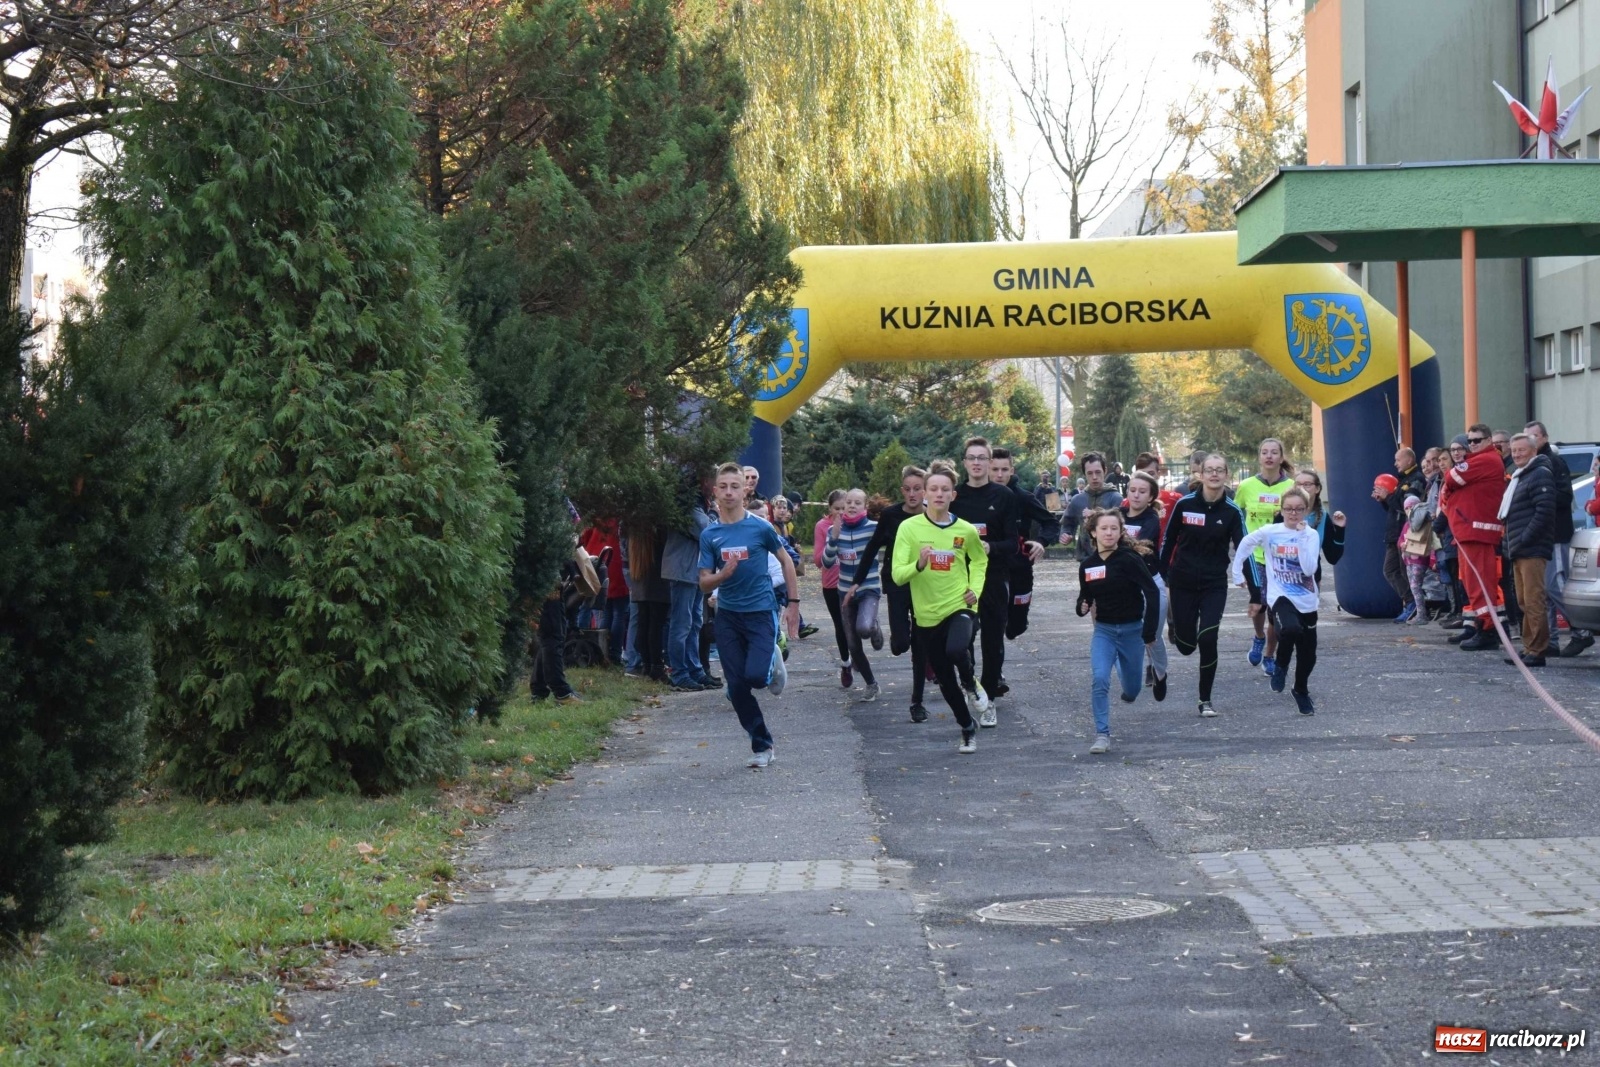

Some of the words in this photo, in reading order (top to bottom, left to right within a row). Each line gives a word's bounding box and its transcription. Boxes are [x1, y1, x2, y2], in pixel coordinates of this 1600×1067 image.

[993, 266, 1094, 291] GMINA
[880, 300, 994, 330] KUŹNIA
[1003, 297, 1211, 327] RACIBORSKA
[935, 555, 948, 563] 031
